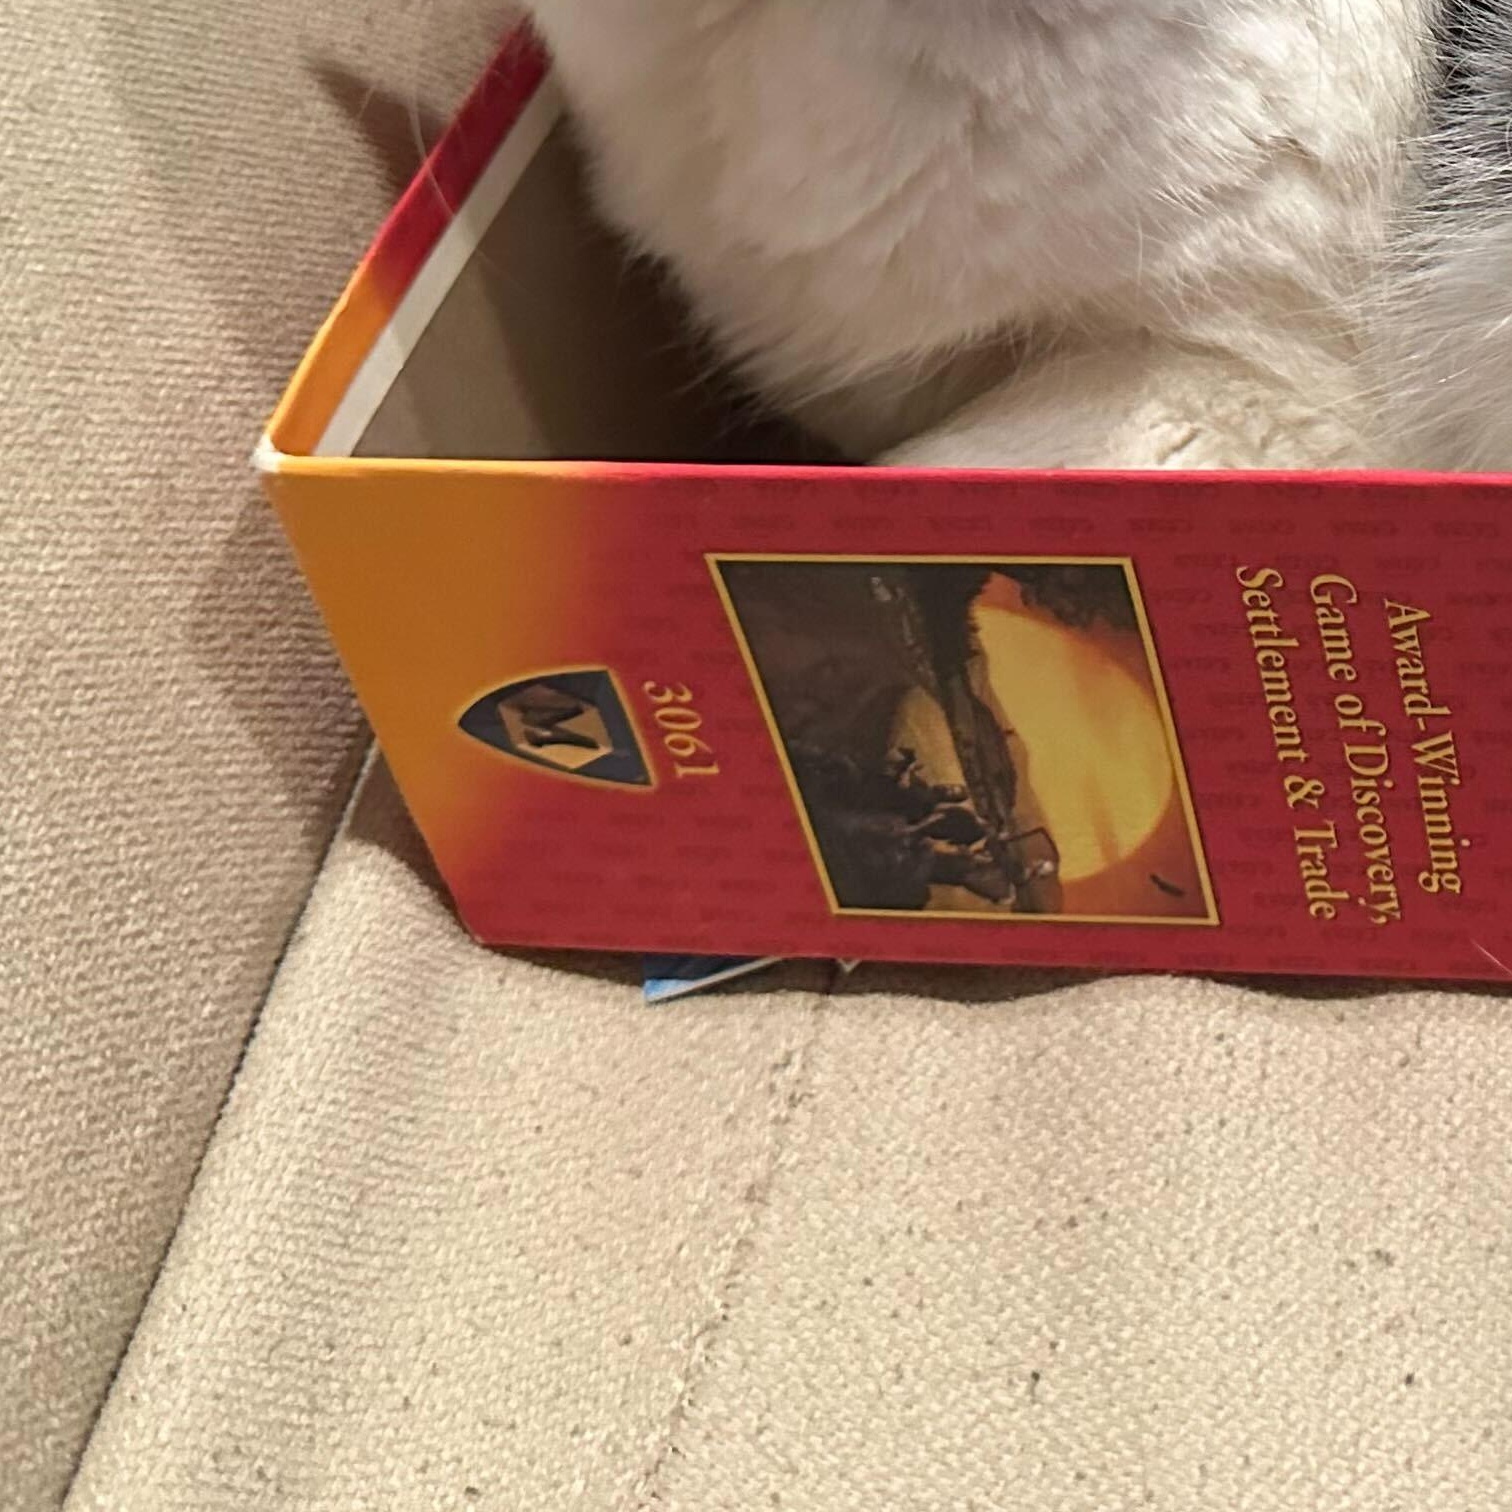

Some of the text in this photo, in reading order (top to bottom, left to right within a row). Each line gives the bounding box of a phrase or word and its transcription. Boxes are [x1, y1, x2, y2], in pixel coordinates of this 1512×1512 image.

[643, 680, 720, 780] 3061
[1235, 565, 1349, 920] Settlement & Trade
[1309, 573, 1401, 925] Game of Discovery,
[1384, 598, 1471, 894] Award-Winning
